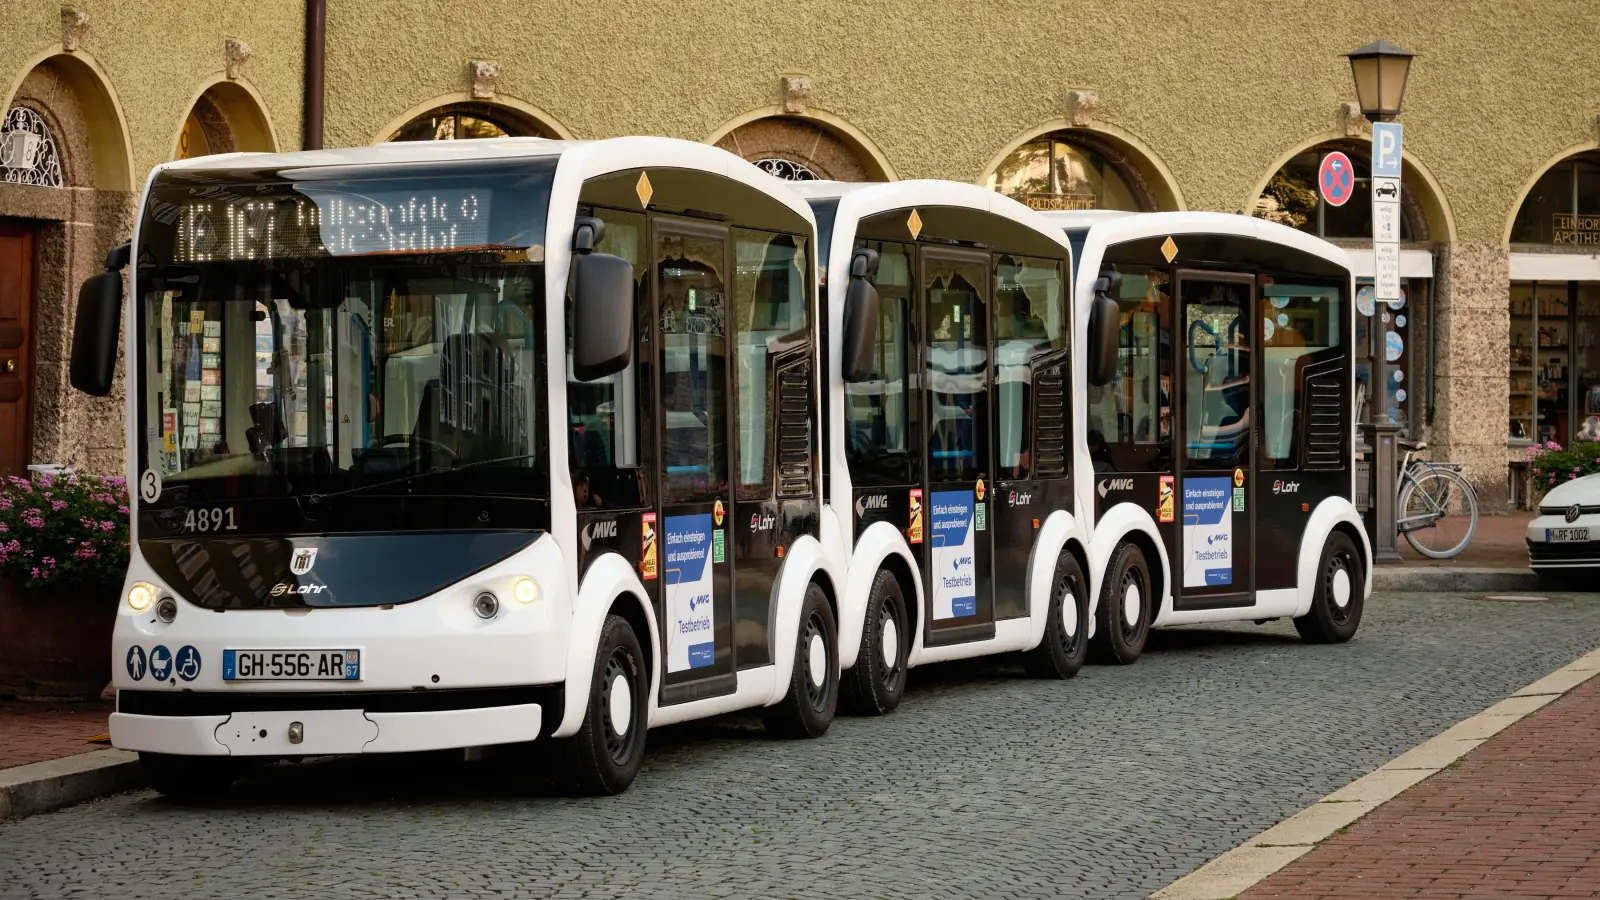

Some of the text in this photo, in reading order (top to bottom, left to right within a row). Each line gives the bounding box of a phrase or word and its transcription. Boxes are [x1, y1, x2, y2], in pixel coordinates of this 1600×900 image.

[26, 141, 33, 161] 8
[1379, 129, 1395, 169] P
[146, 472, 157, 499] 3
[1108, 478, 1134, 491] MVG
[1281, 480, 1300, 493] Lohr
[1016, 491, 1031, 505] Lohr
[1185, 488, 1225, 499] Einfach einsteigen
[865, 494, 888, 509] MVG
[1185, 502, 1194, 510] und
[933, 503, 968, 516] Einfach einsteigen
[184, 506, 238, 532] 4891
[758, 514, 775, 530] Lohr
[933, 520, 941, 530] und
[592, 520, 617, 539] MVG
[1569, 529, 1588, 541] 1002
[667, 530, 706, 545] Einfach einsteigen
[667, 549, 677, 562] und
[959, 556, 972, 566] MVG
[1195, 550, 1228, 561] Testbetrieb
[942, 573, 972, 589] Testbetrieb
[287, 583, 328, 595] Lohr
[695, 593, 710, 605] MVG
[678, 615, 711, 634] Testbetrieb
[346, 665, 358, 677] 67
